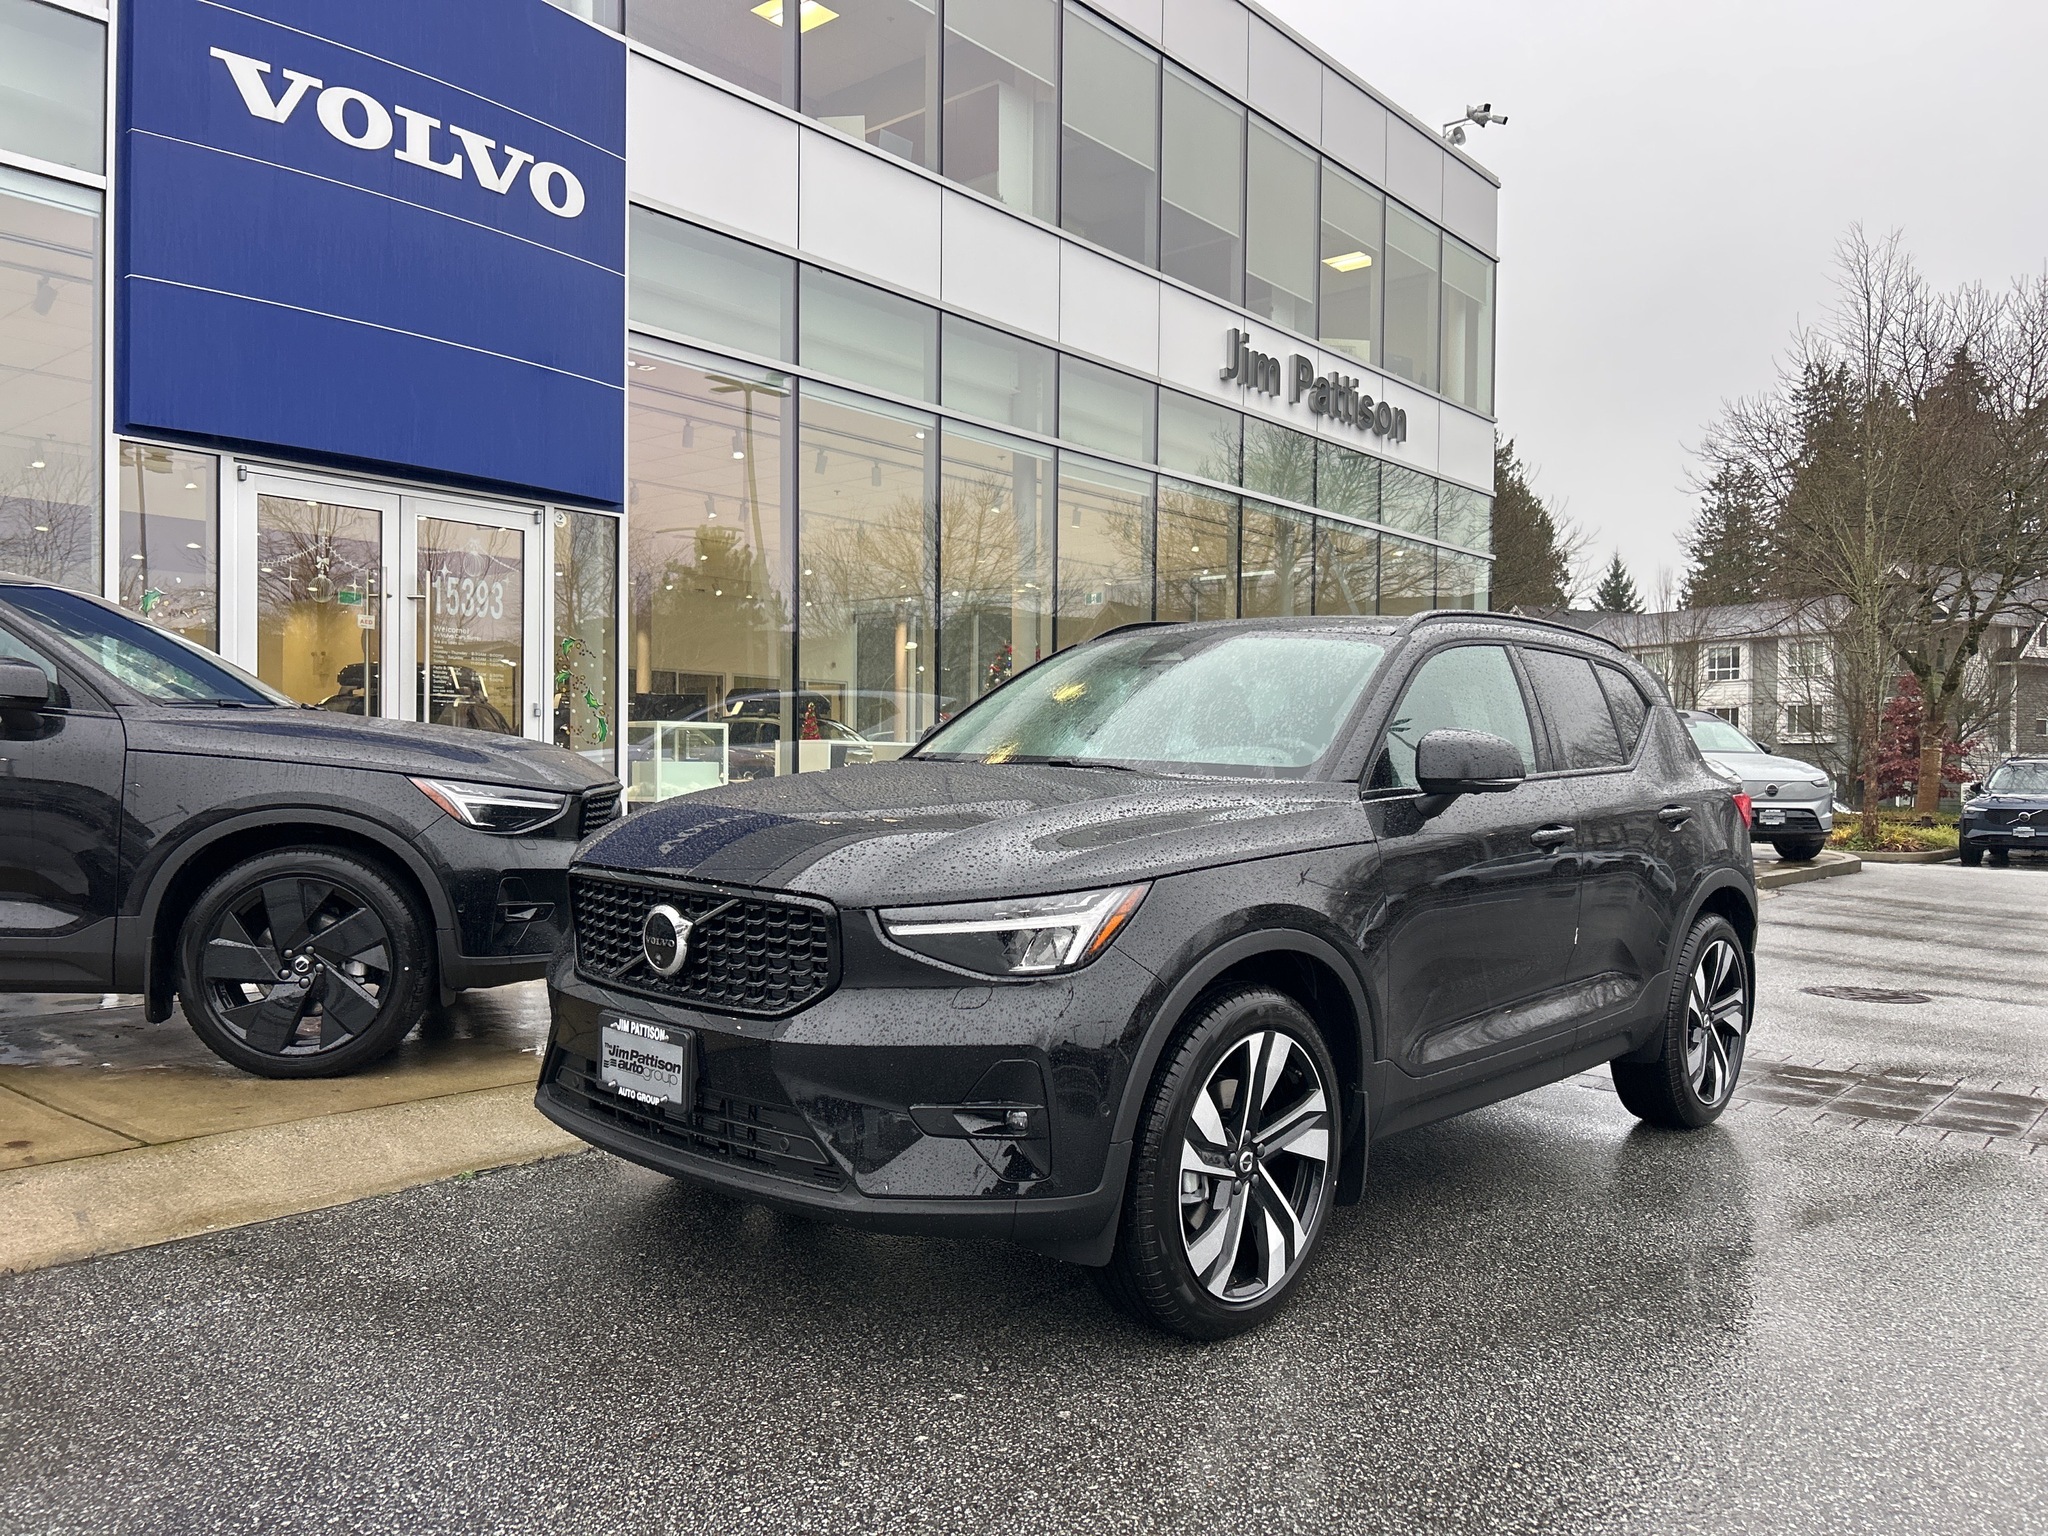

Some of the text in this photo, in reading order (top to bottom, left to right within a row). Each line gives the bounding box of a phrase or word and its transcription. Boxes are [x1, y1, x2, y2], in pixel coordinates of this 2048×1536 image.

[210, 46, 585, 218] VOLVO
[1220, 327, 1407, 443] Jim Pattison
[432, 576, 503, 620] 15393
[645, 934, 675, 948] VOLVO
[617, 1018, 666, 1041] JIM PATTISON
[618, 1086, 660, 1106] AUTO GROUP
